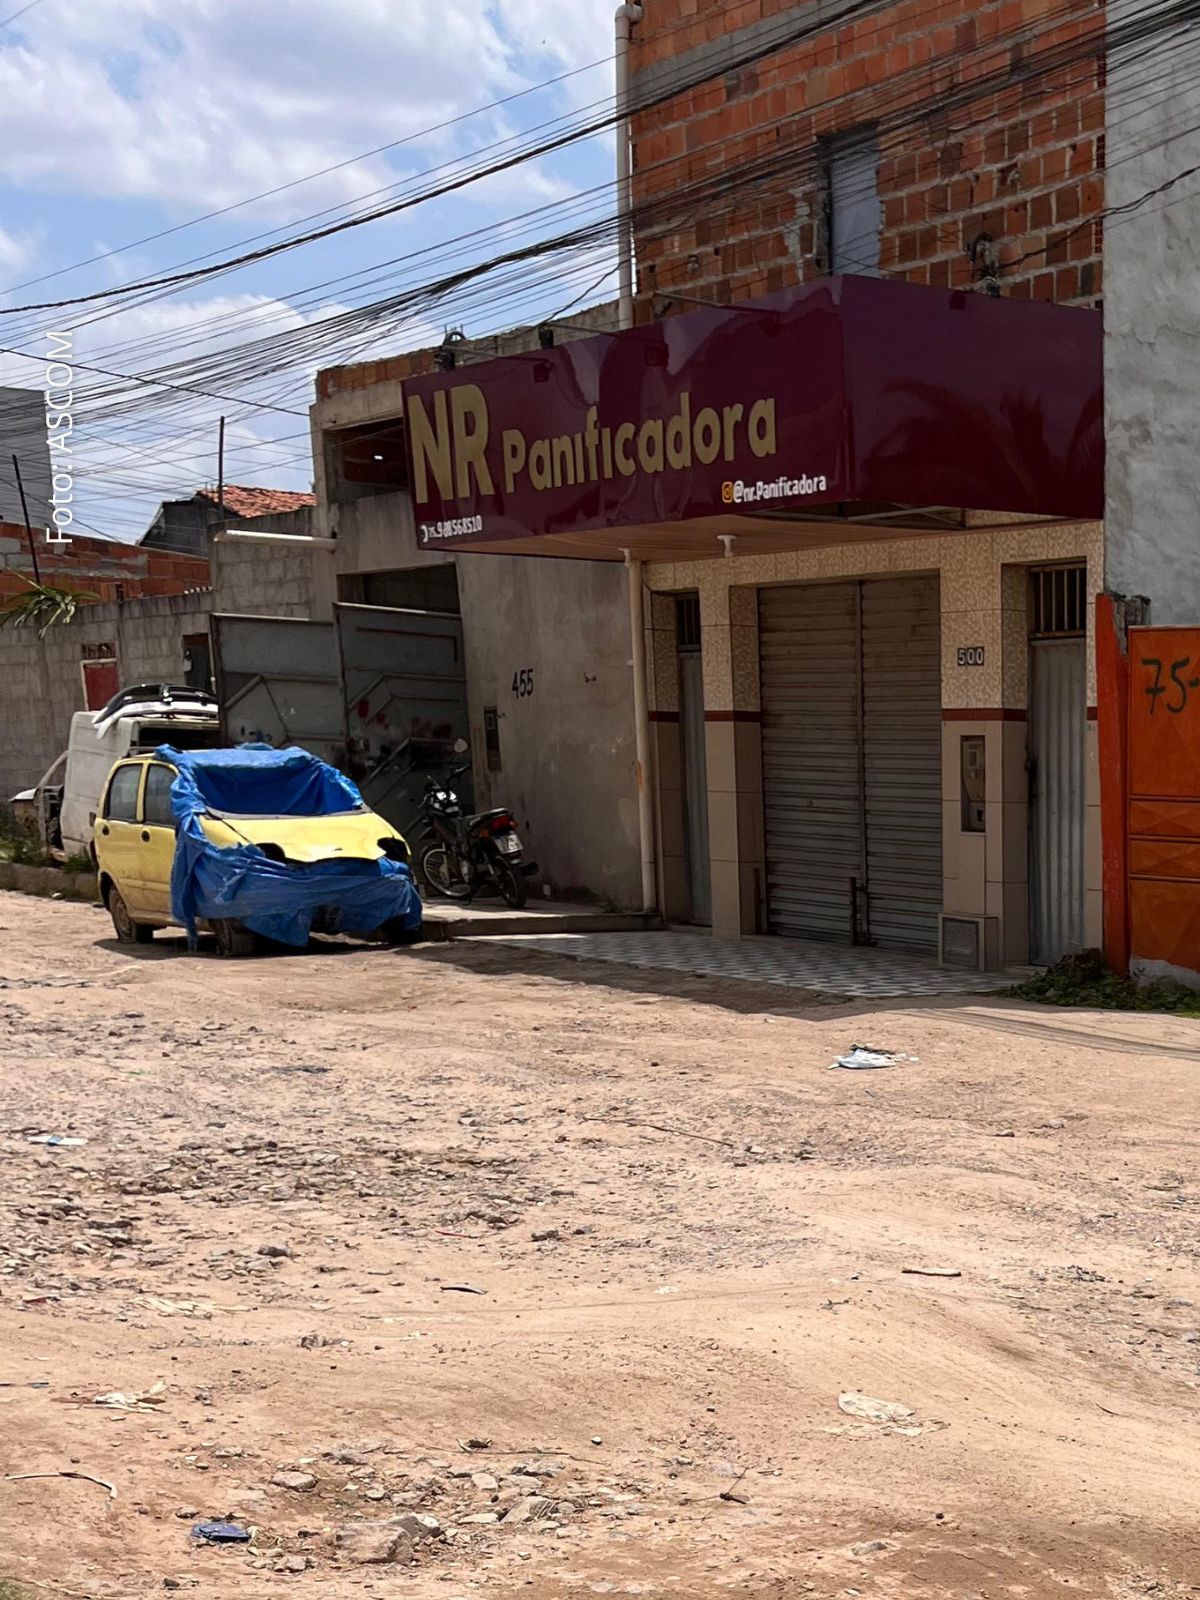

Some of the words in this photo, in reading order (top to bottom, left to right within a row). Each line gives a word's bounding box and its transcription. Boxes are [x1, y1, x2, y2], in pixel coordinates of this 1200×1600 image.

[407, 383, 494, 503] NR
[503, 391, 777, 494] Panificadora
[957, 647, 985, 666] 500
[511, 668, 534, 700] 455
